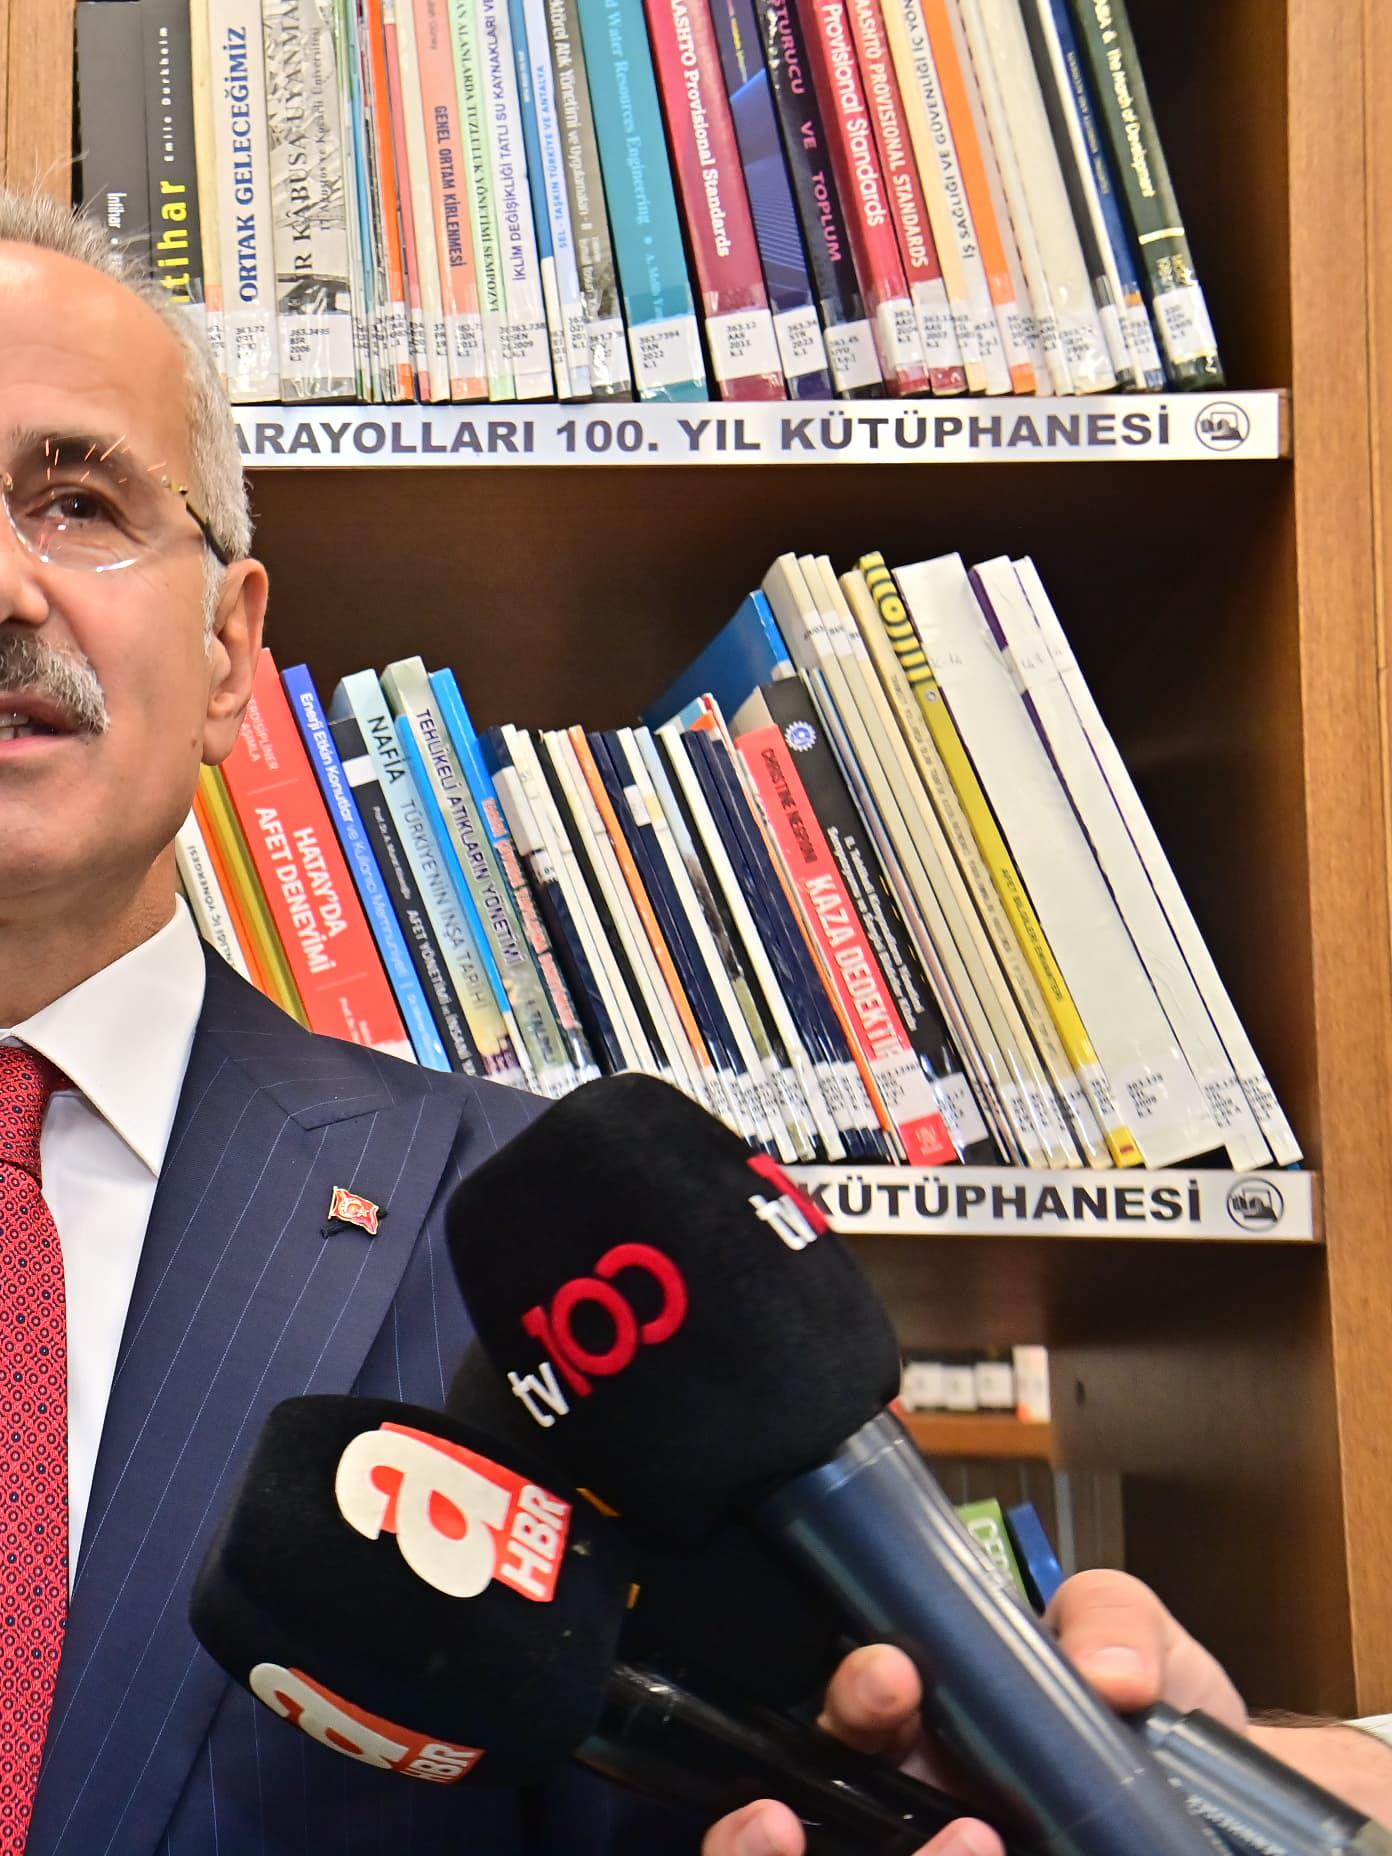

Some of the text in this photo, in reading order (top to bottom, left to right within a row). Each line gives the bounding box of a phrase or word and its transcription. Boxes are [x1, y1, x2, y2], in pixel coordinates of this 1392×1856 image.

[911, 36, 924, 53] İÇ
[913, 57, 947, 144] GÜVENLİĞİ
[224, 26, 258, 303] ORTAK GELECEĞİMİZ
[485, 15, 526, 281] İKLİM DEĞİŞİKLİĞİ TATLI SU KAYNAKLARI
[608, 11, 651, 225] Water Resources Engineering
[683, 69, 716, 166] Provisional
[702, 168, 733, 257] Standards
[823, 2, 887, 228] Provisional Standards
[869, 63, 906, 171] PROVISIONAL
[892, 174, 929, 268] STANDARDS
[939, 151, 953, 172] VE
[434, 105, 467, 268] GENEL ORTAM KİRLENMESİ
[799, 120, 817, 149] VE
[811, 171, 843, 262] TOPLUM
[944, 176, 971, 240] SAĞLIĞI
[961, 245, 977, 260] İŞ
[233, 404, 1170, 454] ARAYOLLARI 100. YIL KÜTÜPHANESİ
[300, 692, 321, 732] Enerji
[312, 730, 333, 766] Etkin
[325, 763, 355, 824] Konutlar
[366, 714, 407, 785] NAFİA
[256, 807, 336, 974] AFET DENEYİMİ
[293, 827, 347, 938] HATAY'DA
[416, 709, 526, 968] TEHLİKELİ ATIKLARIN YÖNETİMİ
[806, 874, 852, 949] KAZA
[798, 1176, 1201, 1223] KÜTÜPHANESİ
[335, 1430, 512, 1598] a
[501, 1484, 569, 1597] HBR
